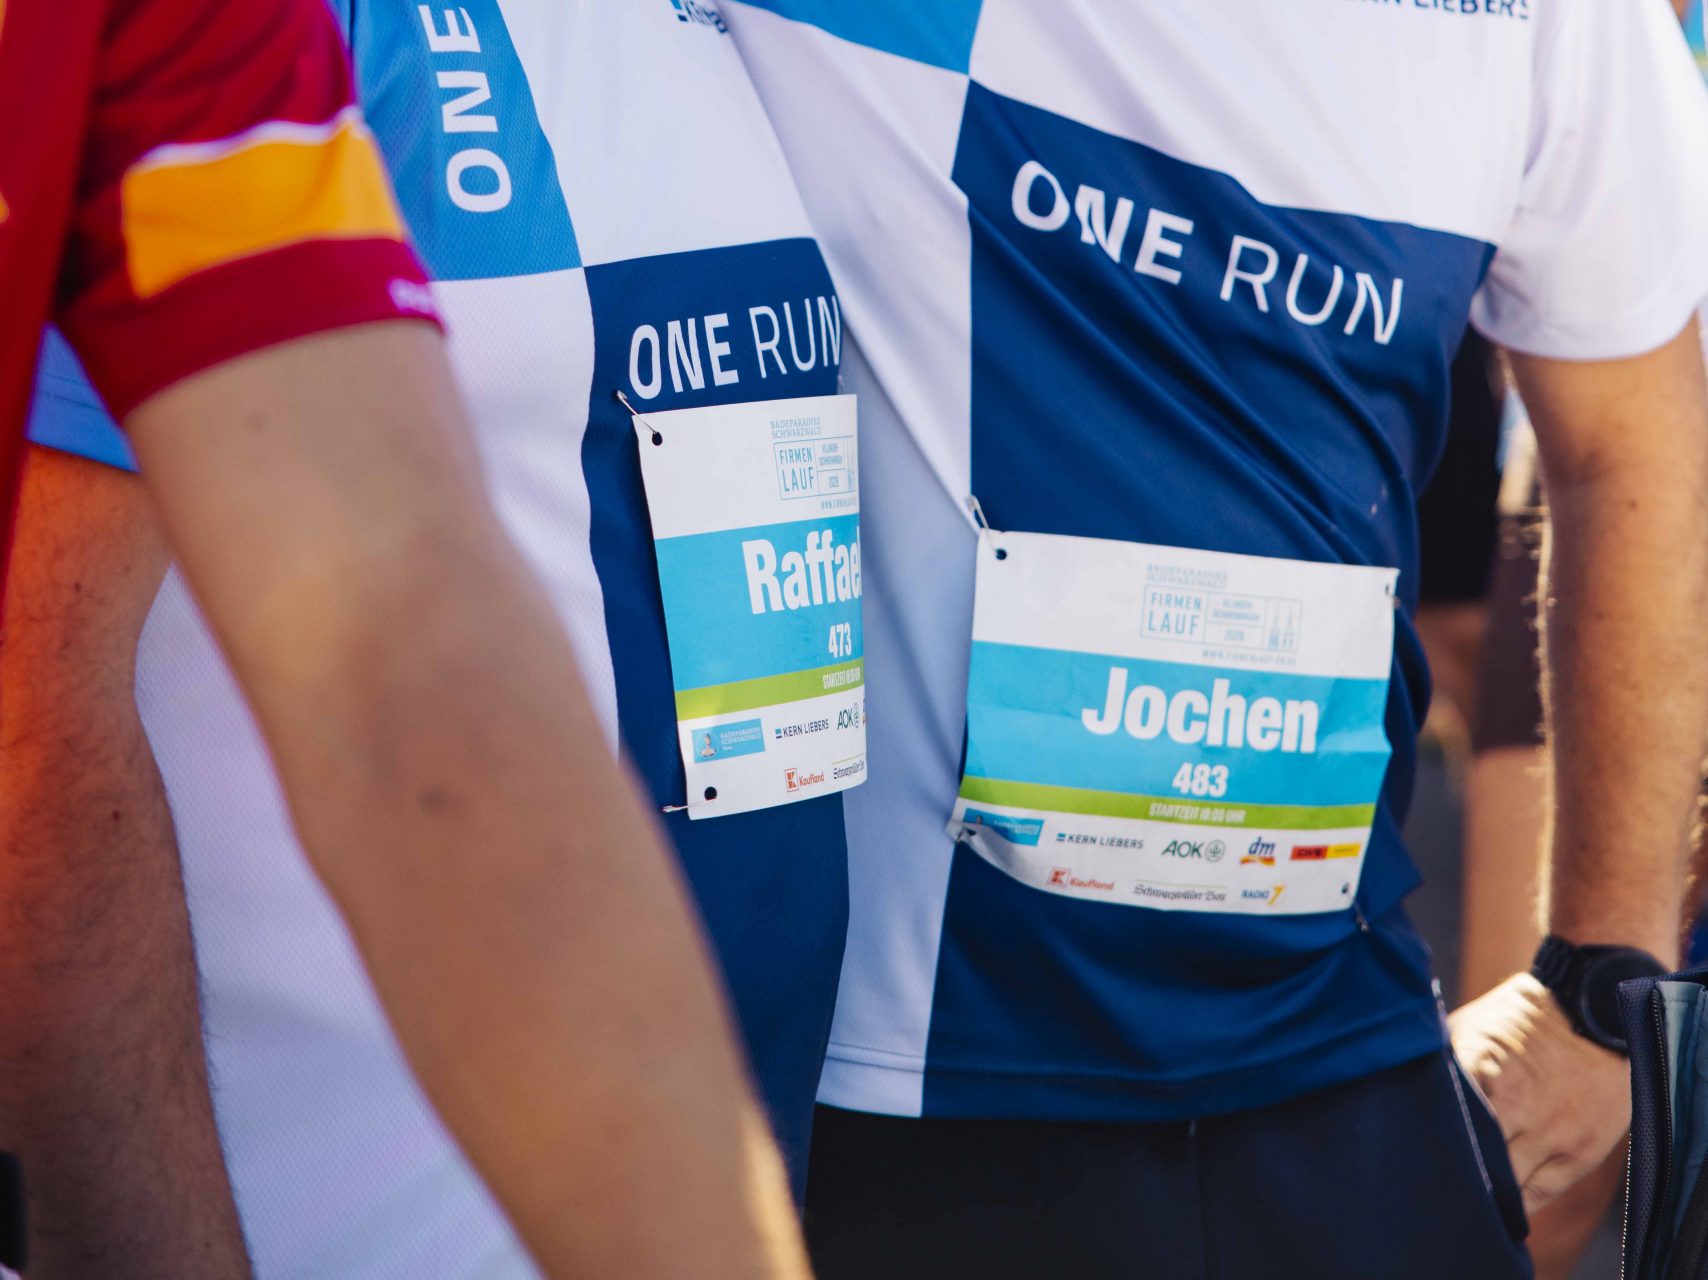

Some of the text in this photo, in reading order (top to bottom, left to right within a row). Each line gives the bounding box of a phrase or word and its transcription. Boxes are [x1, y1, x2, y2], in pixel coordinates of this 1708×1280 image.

[417, 4, 513, 213] ONE
[1011, 160, 1404, 345] ONE RUN
[629, 295, 842, 400] ONE RUN
[779, 447, 813, 464] FIRMEN
[782, 467, 814, 492] LAUF
[1151, 591, 1202, 610] FIRMEN
[1148, 610, 1200, 635] LAUF
[828, 622, 852, 658] 473
[837, 707, 854, 730] AOK
[1081, 666, 1319, 753] Jochen
[783, 718, 830, 738] KERN LIEBERS
[799, 770, 825, 787] Kaufland
[1172, 762, 1229, 798] 483
[1067, 833, 1144, 849] KERN LIEBERS
[1161, 839, 1204, 859] AOK
[1248, 836, 1276, 856] dm
[1069, 877, 1115, 891] Kaufland
